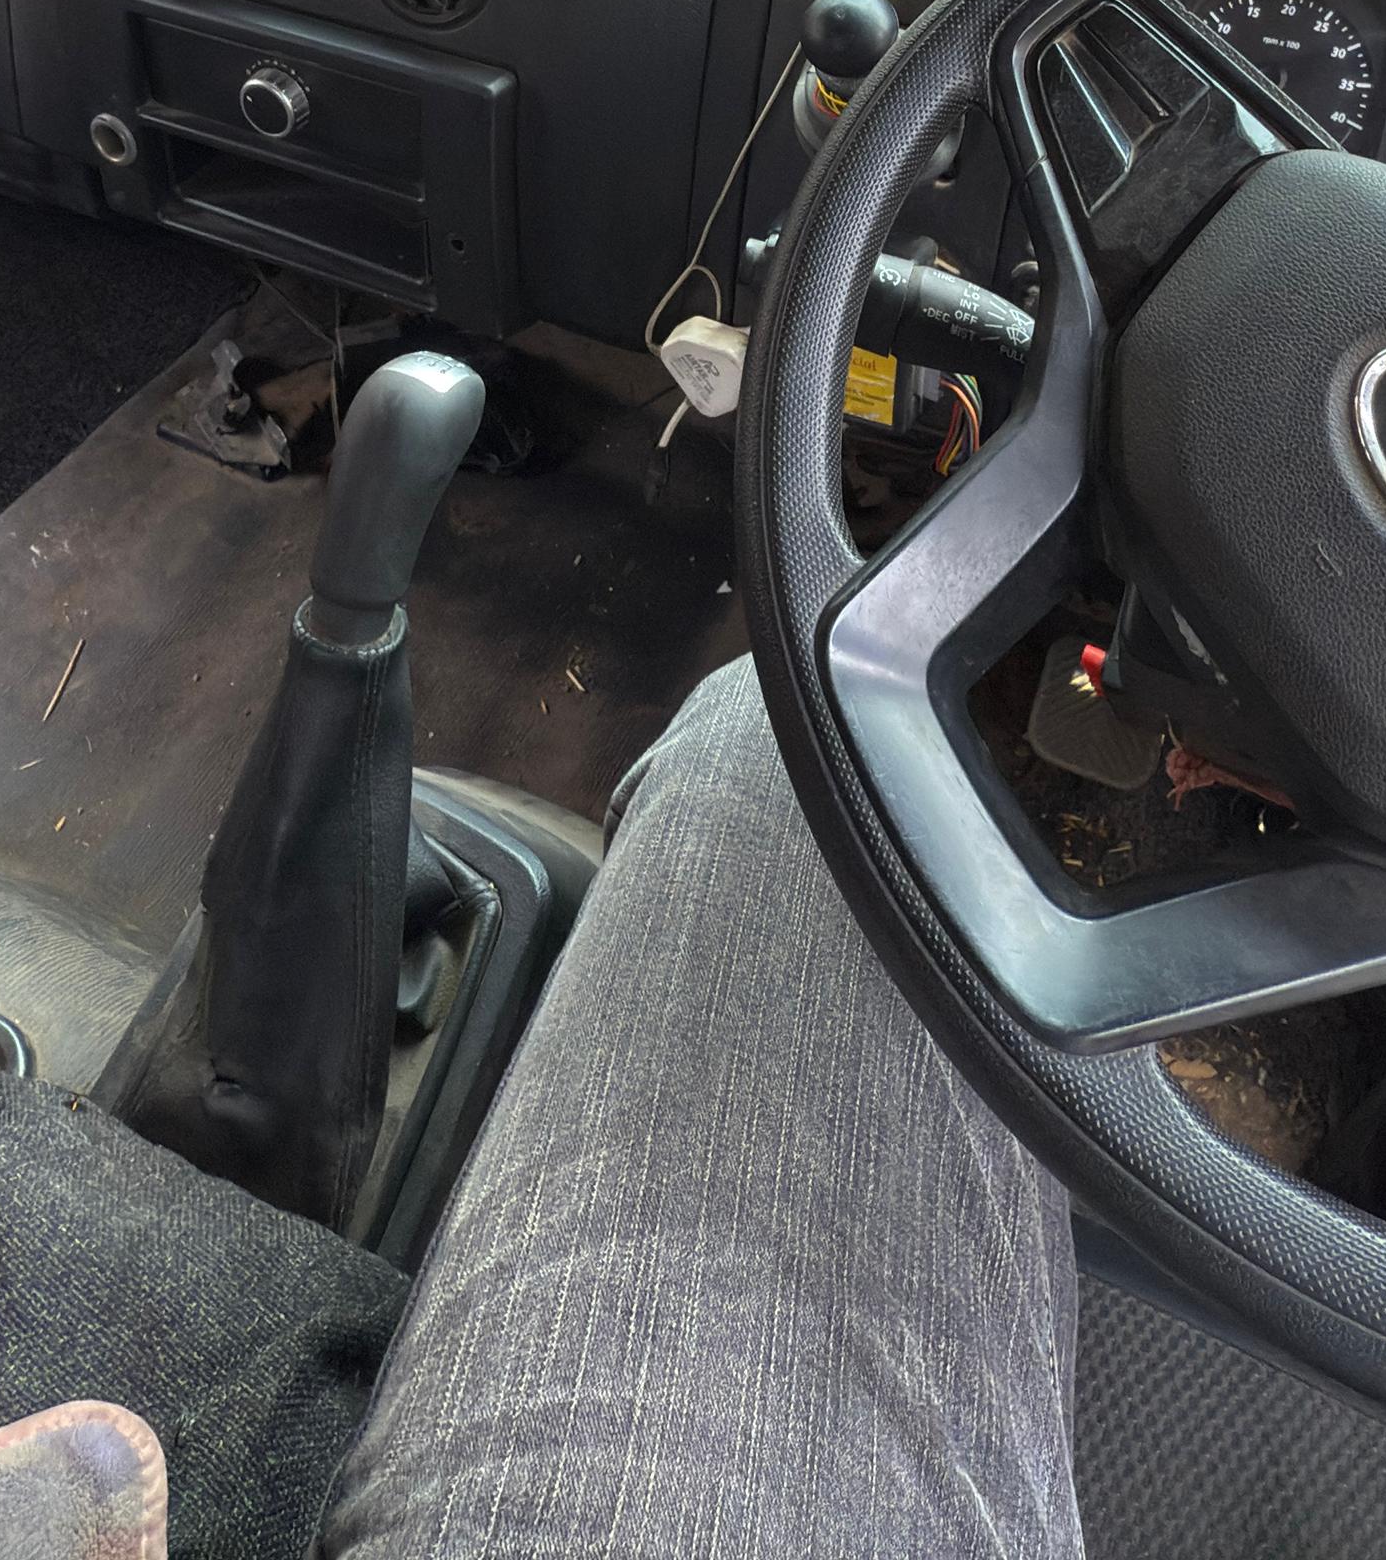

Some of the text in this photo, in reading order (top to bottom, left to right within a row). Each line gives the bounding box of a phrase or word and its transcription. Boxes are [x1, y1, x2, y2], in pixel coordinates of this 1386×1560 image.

[1246, 6, 1261, 19] 15
[1280, 3, 1297, 17] 20
[1217, 22, 1231, 35] 10
[1313, 20, 1330, 34] 25
[1286, 40, 1301, 51] 100
[1330, 46, 1347, 60] 30
[1338, 78, 1355, 92] 35
[1330, 111, 1347, 124] 40
[963, 289, 981, 301] LO
[959, 299, 981, 313] INT
[927, 306, 951, 323] DEC
[954, 310, 979, 325] OFF
[950, 324, 977, 341] MIST
[999, 344, 1026, 365] PULL
